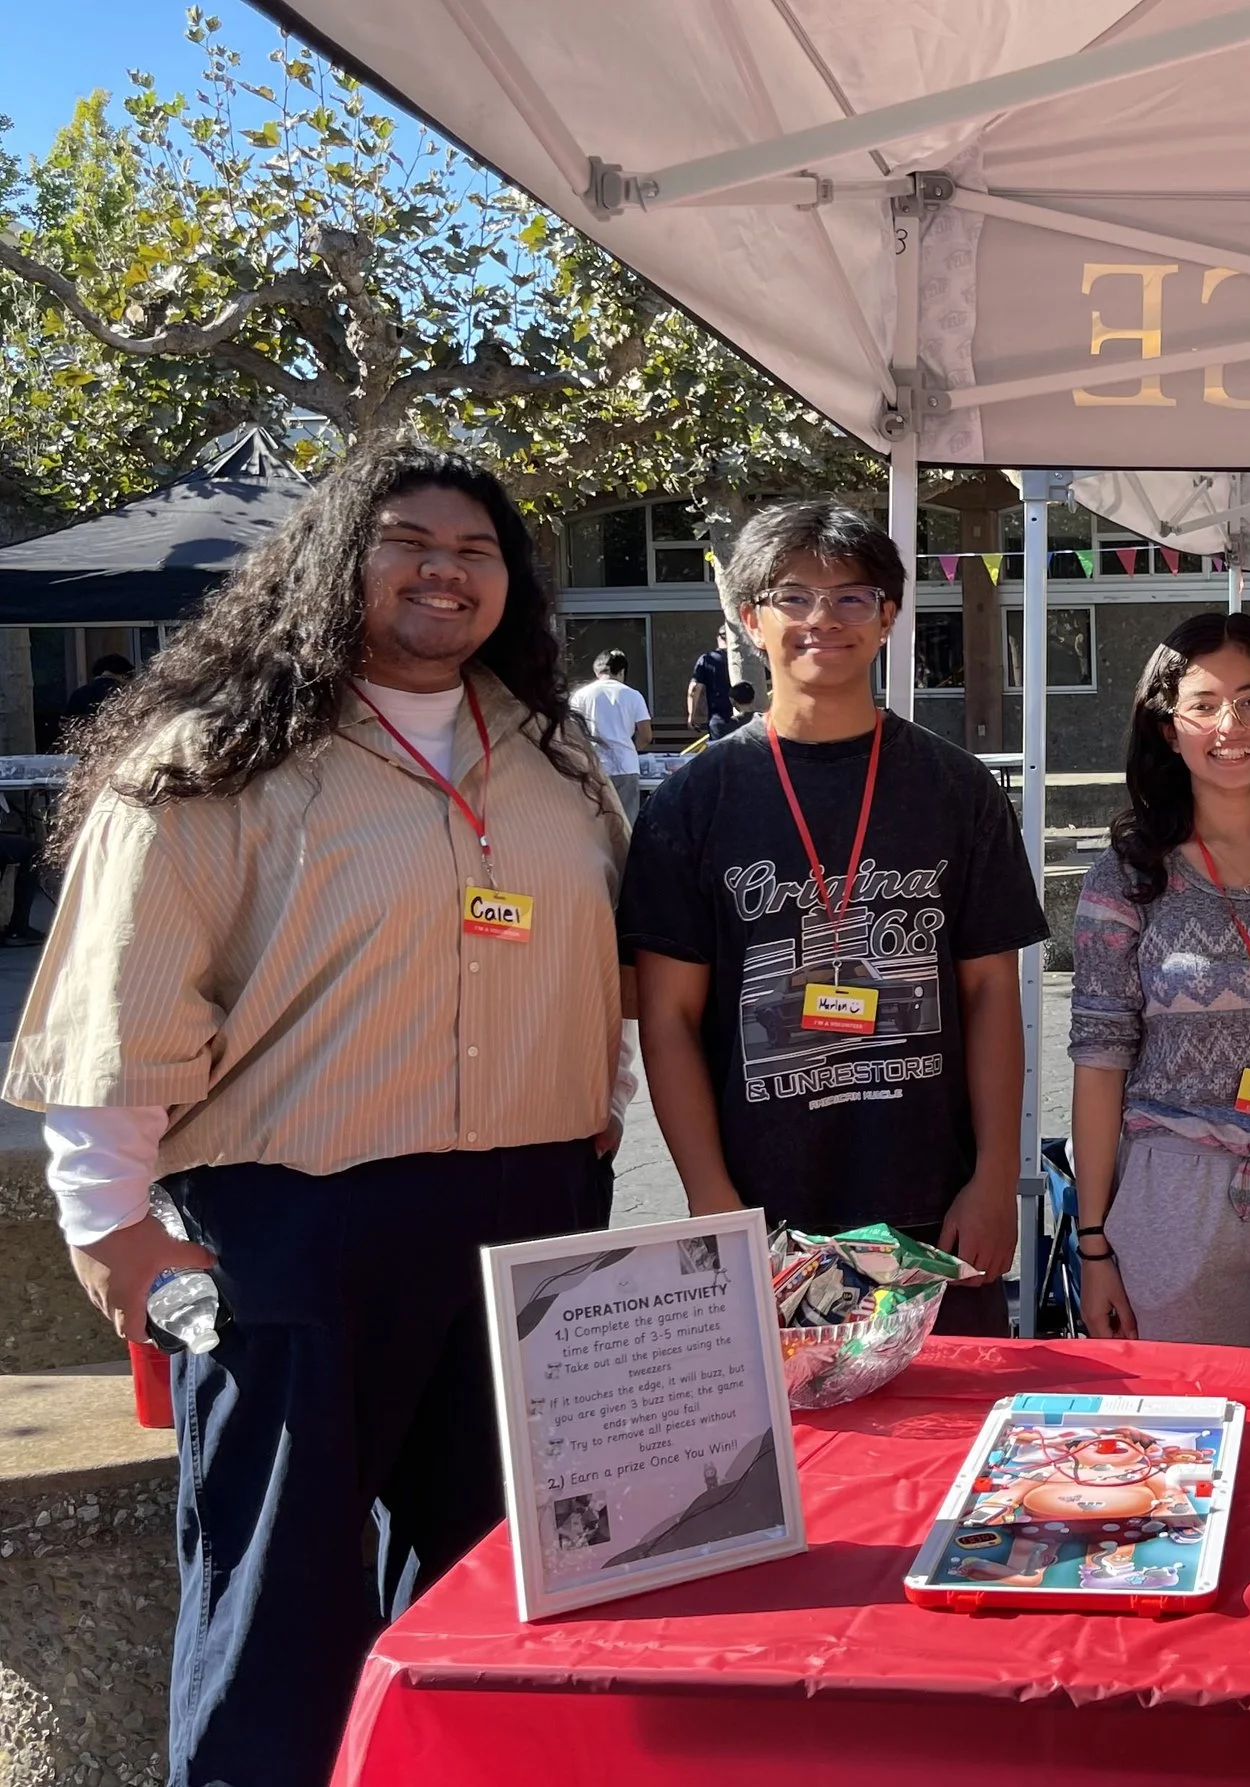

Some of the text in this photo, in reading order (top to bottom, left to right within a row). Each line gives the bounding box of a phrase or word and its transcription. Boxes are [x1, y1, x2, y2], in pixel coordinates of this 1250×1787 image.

[724, 859, 948, 921] Original
[746, 1053, 944, 1103] & UNRESTORED
[555, 1303, 726, 1342] 1.) Complete the game in the
[562, 1283, 728, 1322] OPERATION ACTIVIETY
[562, 1321, 721, 1358] time frame of 3-5 minutes
[564, 1336, 732, 1374] Take out all the pieces using the
[549, 1397, 560, 1409] If
[562, 1396, 571, 1407] it
[574, 1389, 614, 1405] touches
[618, 1385, 635, 1396] the
[638, 1380, 665, 1394] edge,
[668, 1376, 677, 1386] it
[679, 1373, 698, 1385] will
[729, 1364, 745, 1376] but
[629, 1363, 672, 1378] tweezers
[554, 1414, 574, 1427] you
[578, 1410, 596, 1420] are
[600, 1403, 627, 1418] given
[631, 1399, 638, 1409] 3
[642, 1395, 665, 1408] buzz
[697, 1385, 714, 1397] the
[717, 1380, 744, 1395] game
[603, 1418, 627, 1430] ends
[631, 1412, 658, 1425] when
[661, 1409, 680, 1422] you
[571, 1409, 737, 1452] Try to remove all pieces without
[547, 1438, 738, 1490] 2.) Earn a prize Once You Win!!
